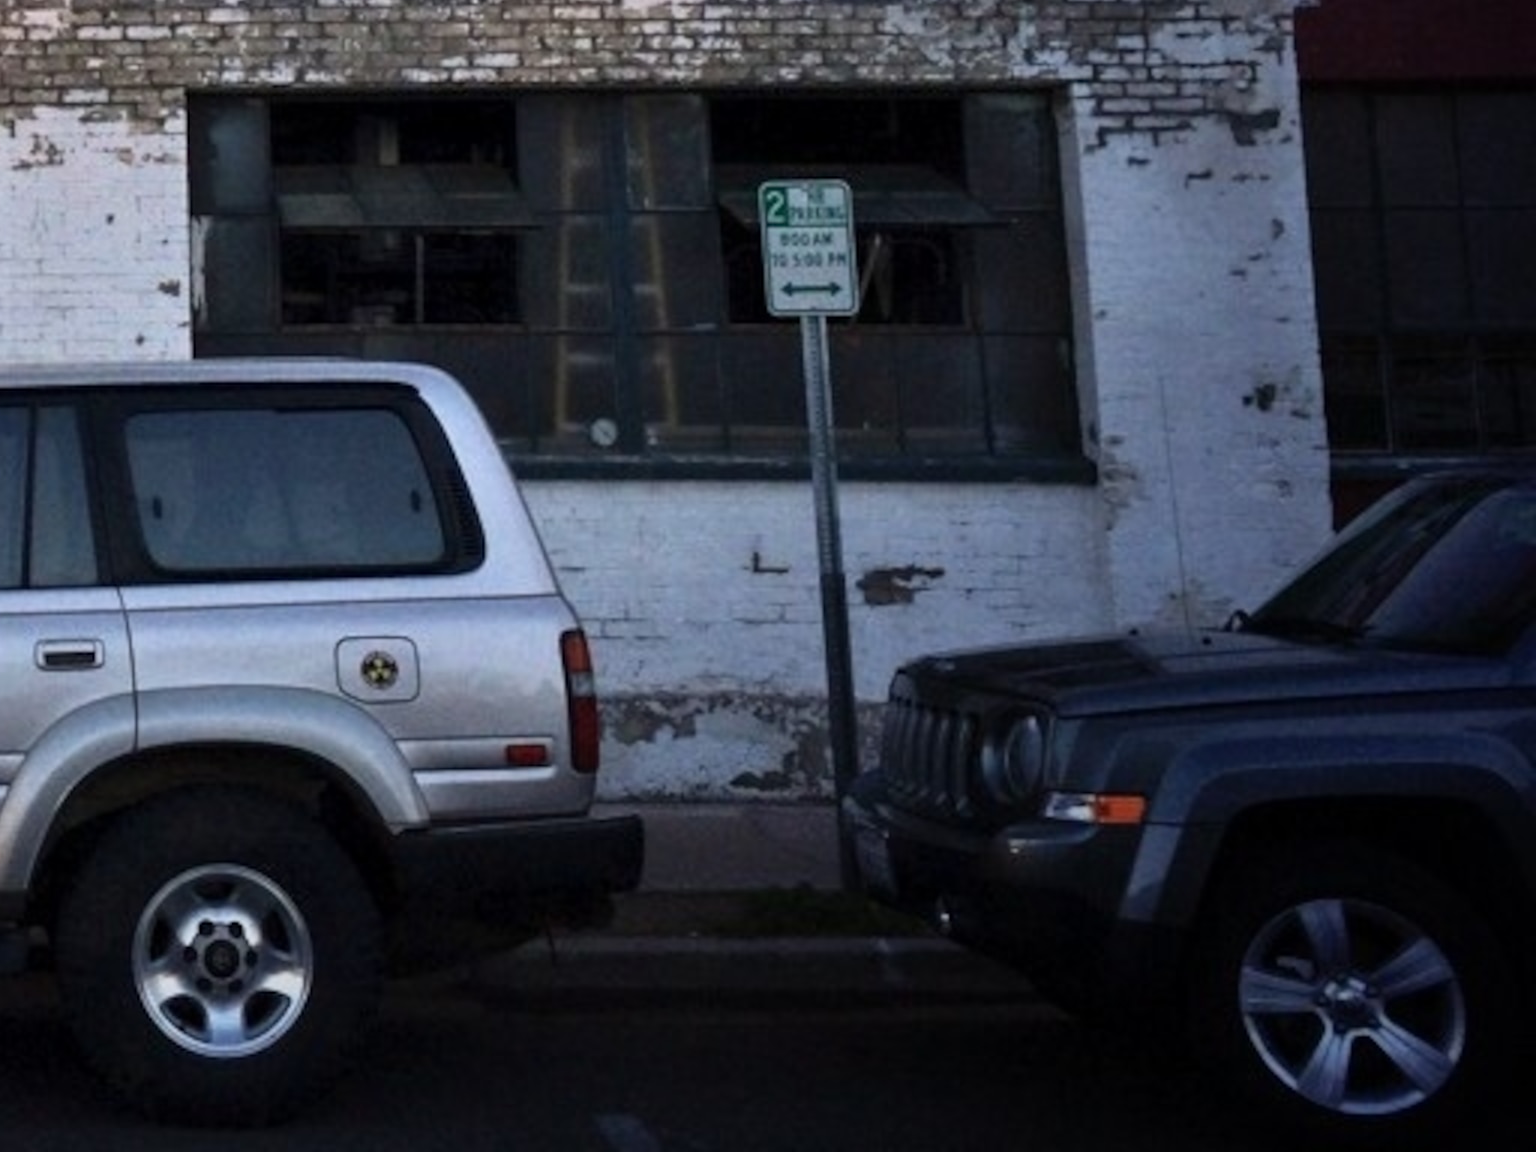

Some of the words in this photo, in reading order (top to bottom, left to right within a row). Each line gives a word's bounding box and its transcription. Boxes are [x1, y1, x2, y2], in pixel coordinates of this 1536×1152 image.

[766, 190, 786, 224] 2
[813, 232, 833, 246] AM
[771, 253, 788, 267] TO
[827, 251, 847, 266] PM
